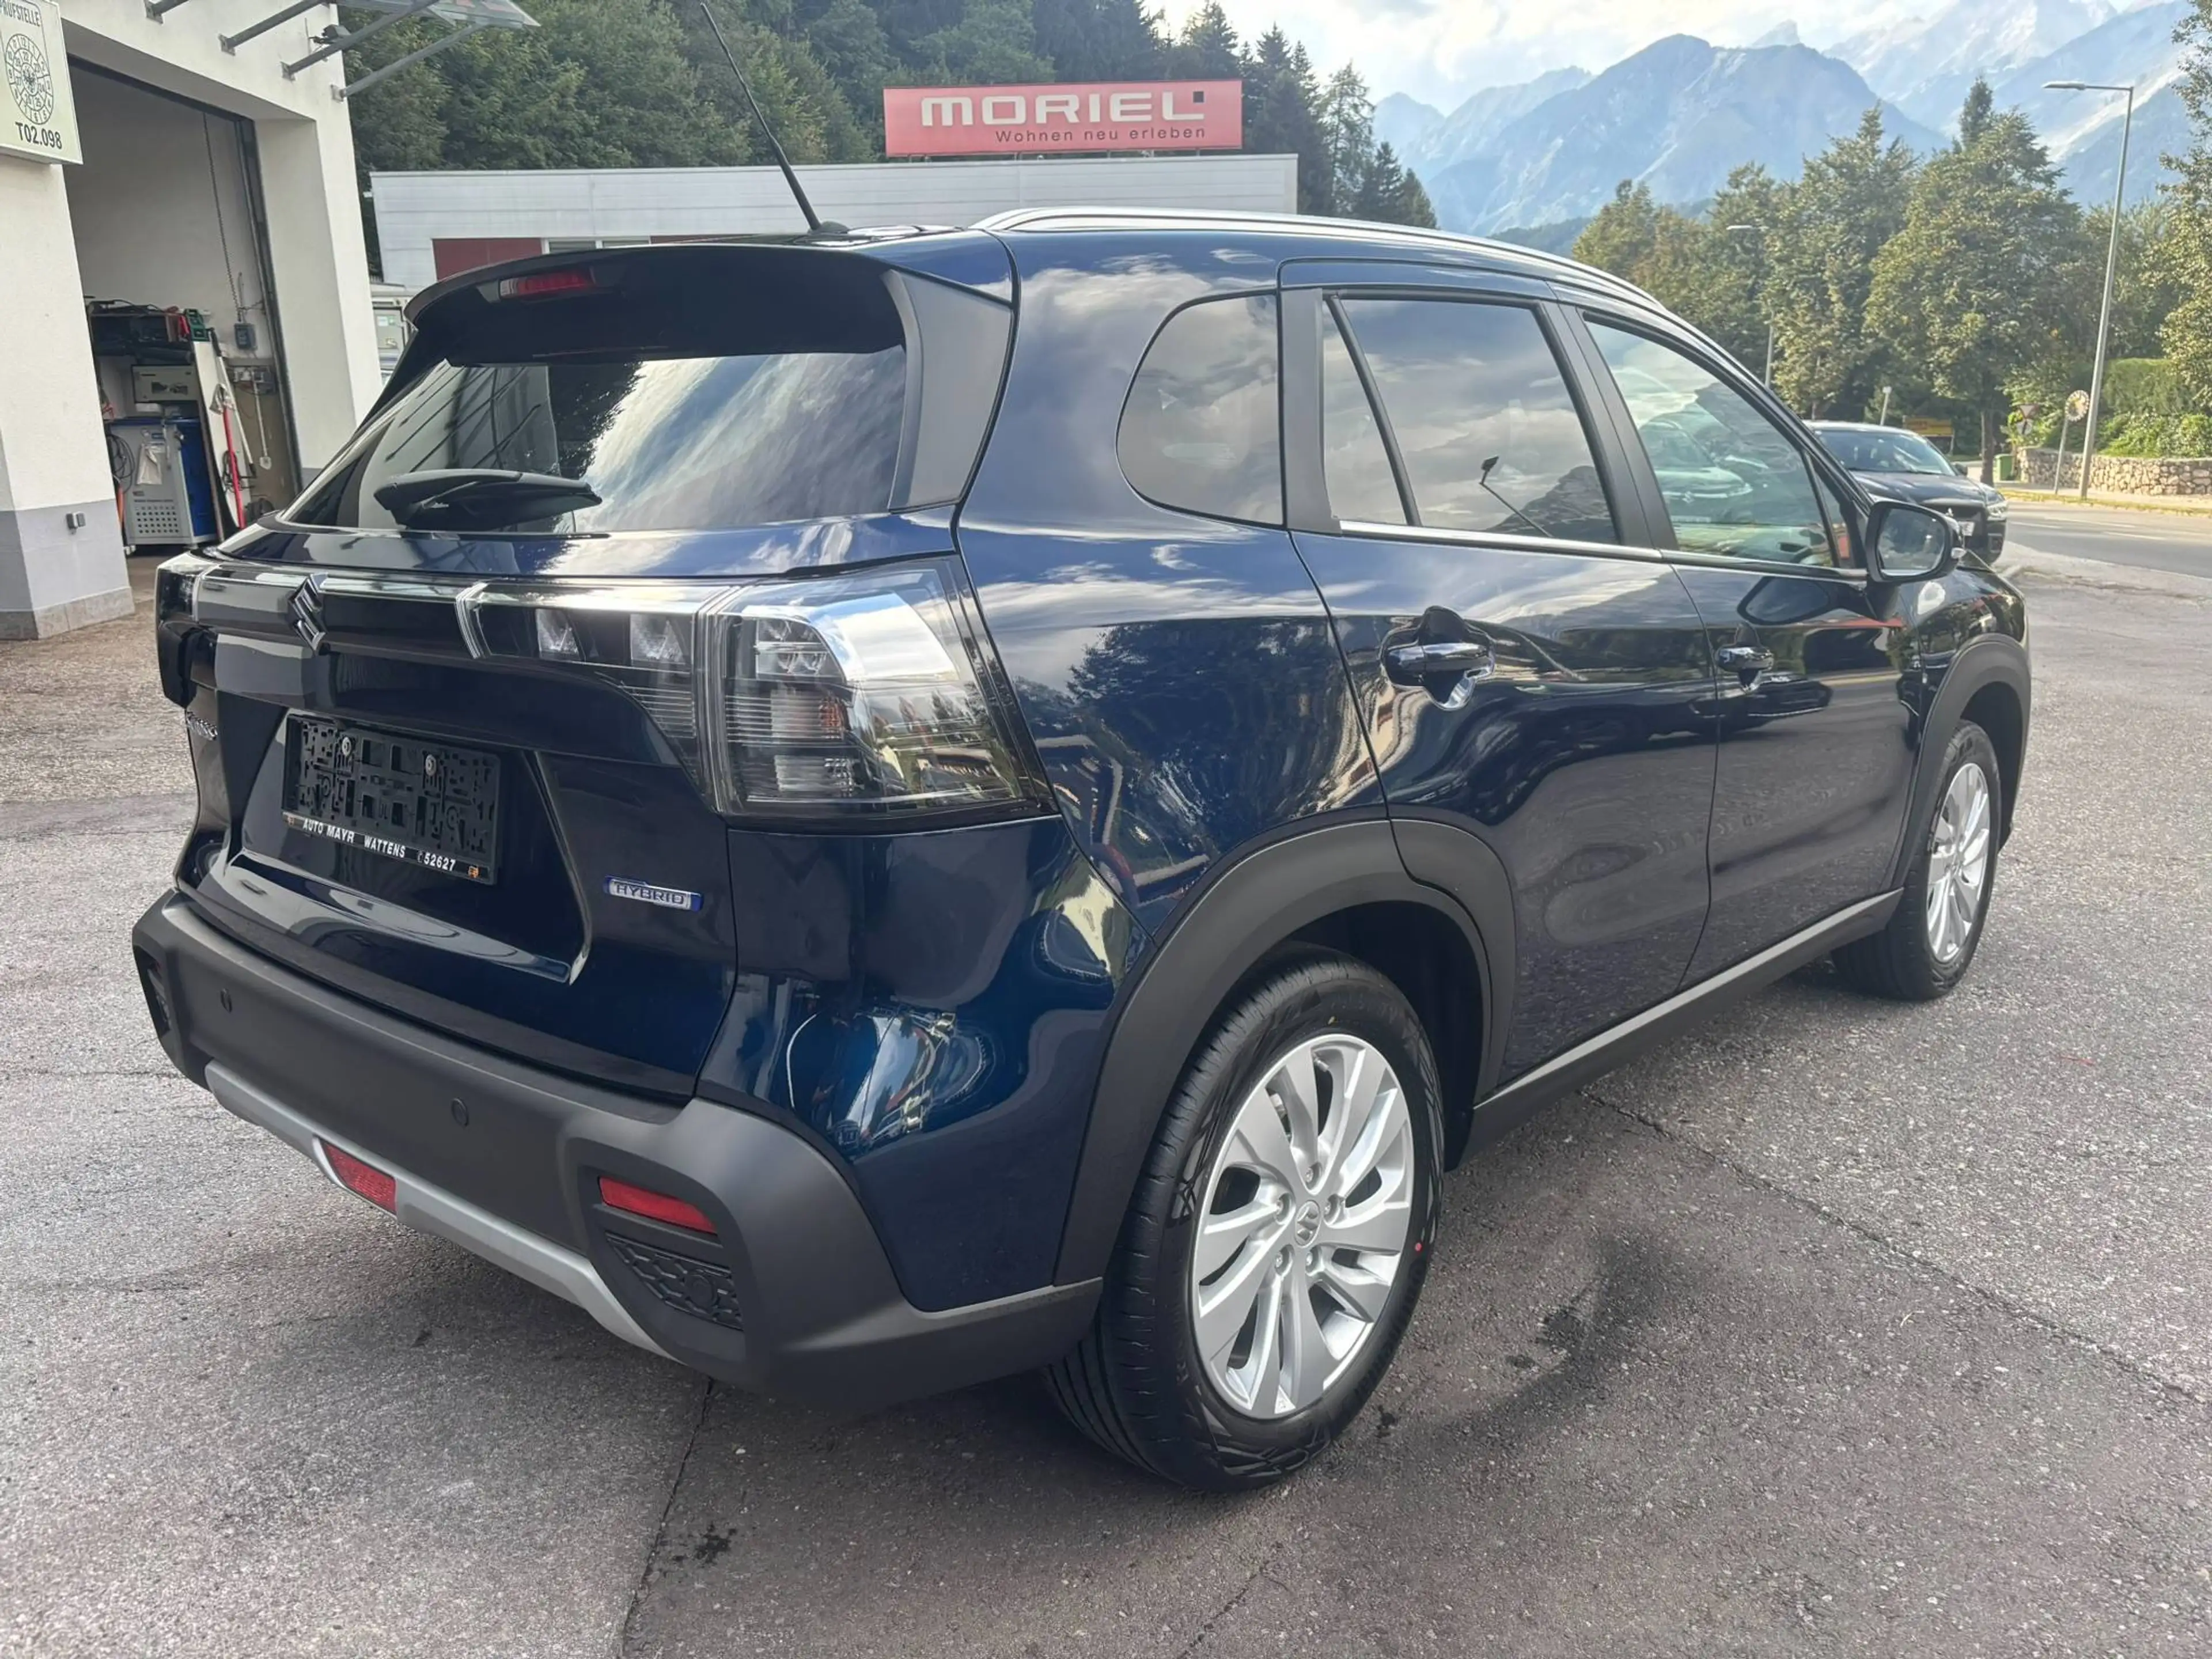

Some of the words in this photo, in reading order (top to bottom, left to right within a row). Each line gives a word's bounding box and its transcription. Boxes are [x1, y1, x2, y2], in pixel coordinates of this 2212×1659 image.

[921, 91, 1205, 127] MORIEL
[15, 122, 62, 149] T02.098
[995, 130, 1073, 142] Wohnen
[1084, 130, 1118, 140] neu
[1129, 126, 1205, 139] erleben
[302, 818, 324, 835] AUTO
[326, 825, 355, 844] MAYR
[363, 835, 406, 858] WATTENS
[423, 852, 456, 872] 52627
[616, 884, 684, 904] HYBRID
